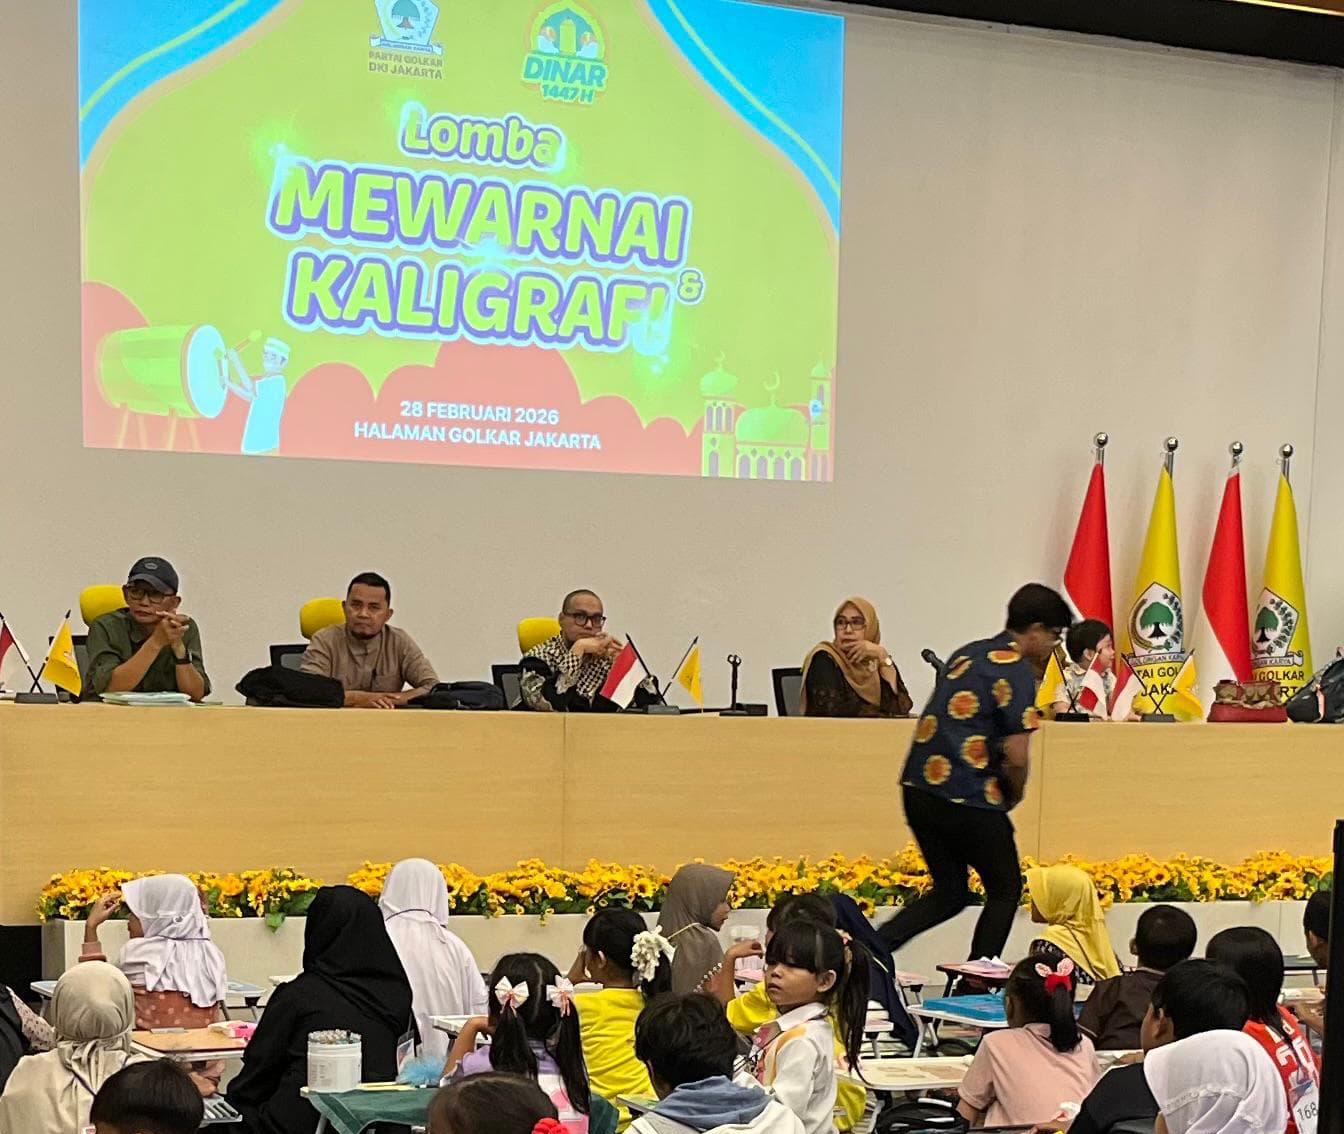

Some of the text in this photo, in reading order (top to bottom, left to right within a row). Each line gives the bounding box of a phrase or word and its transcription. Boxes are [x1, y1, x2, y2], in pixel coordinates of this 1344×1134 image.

[368, 62, 443, 79] DKI JAKARTA
[403, 55, 443, 67] GOLKAR
[523, 56, 606, 87] DINAR
[543, 84, 579, 100] 1447
[403, 108, 561, 165] Lomba
[271, 162, 687, 265] MEWARNAI
[289, 252, 705, 347] KALIGRAFI &
[400, 401, 560, 425] 28 FEBRUARI 2026
[353, 421, 602, 450] HALAMAN GOLKAR JAKARTA
[1258, 670, 1305, 681] GOLKAR
[1297, 1101, 1319, 1120] 168
